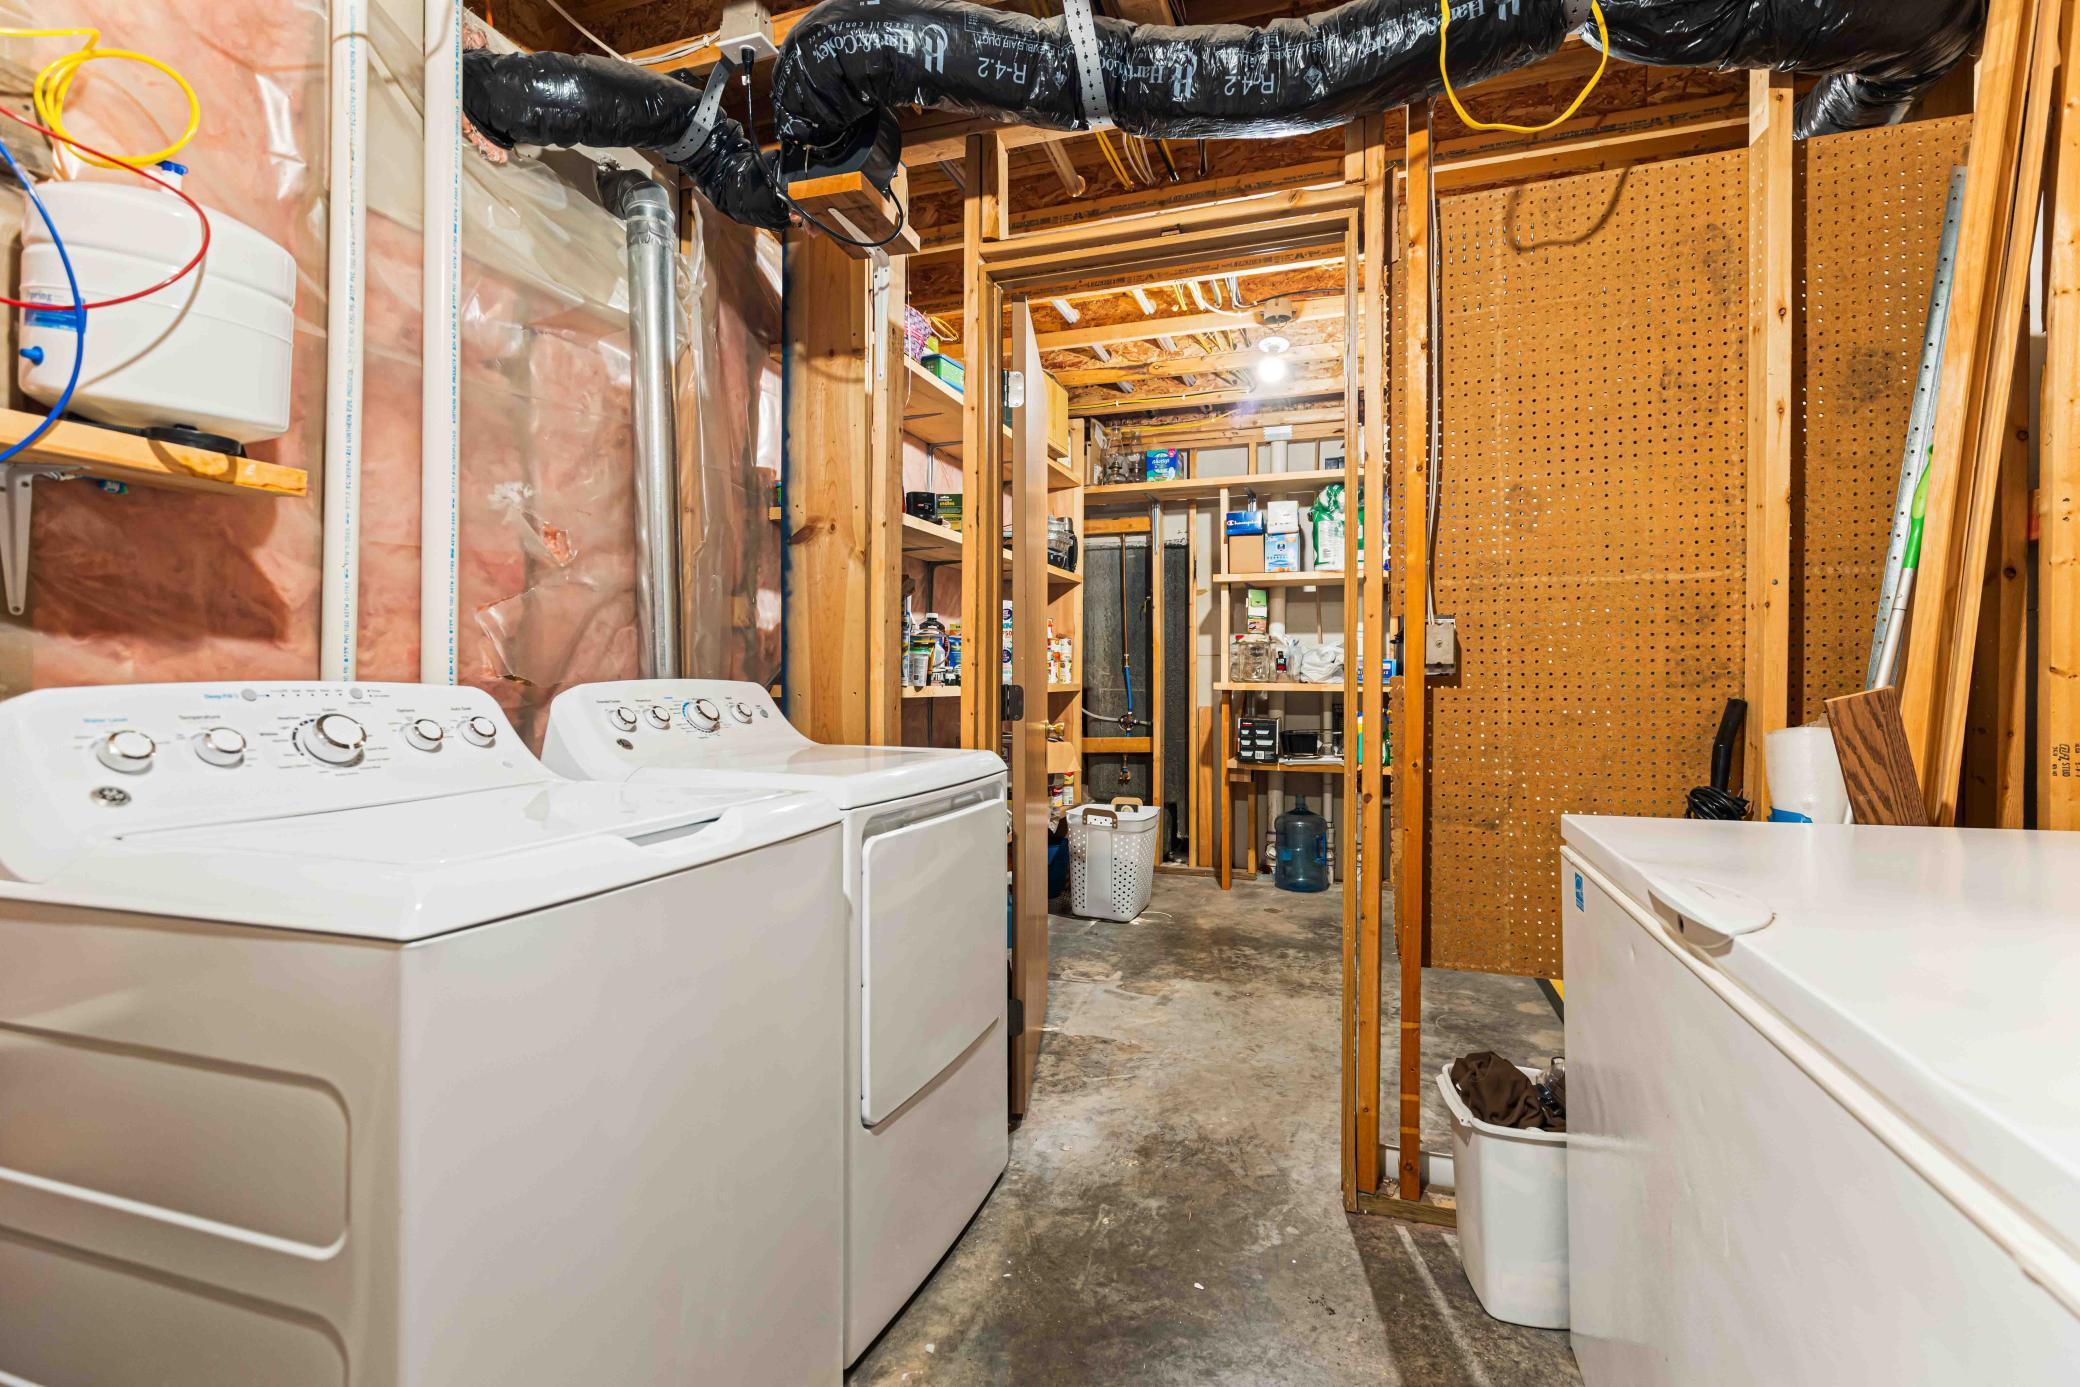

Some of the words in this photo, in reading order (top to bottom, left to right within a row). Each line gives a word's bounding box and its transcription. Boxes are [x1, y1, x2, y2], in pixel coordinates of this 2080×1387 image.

[977, 56, 1027, 85] R-4.2
[1223, 73, 1275, 96] R-4.2
[1226, 519, 1260, 527] Champi
